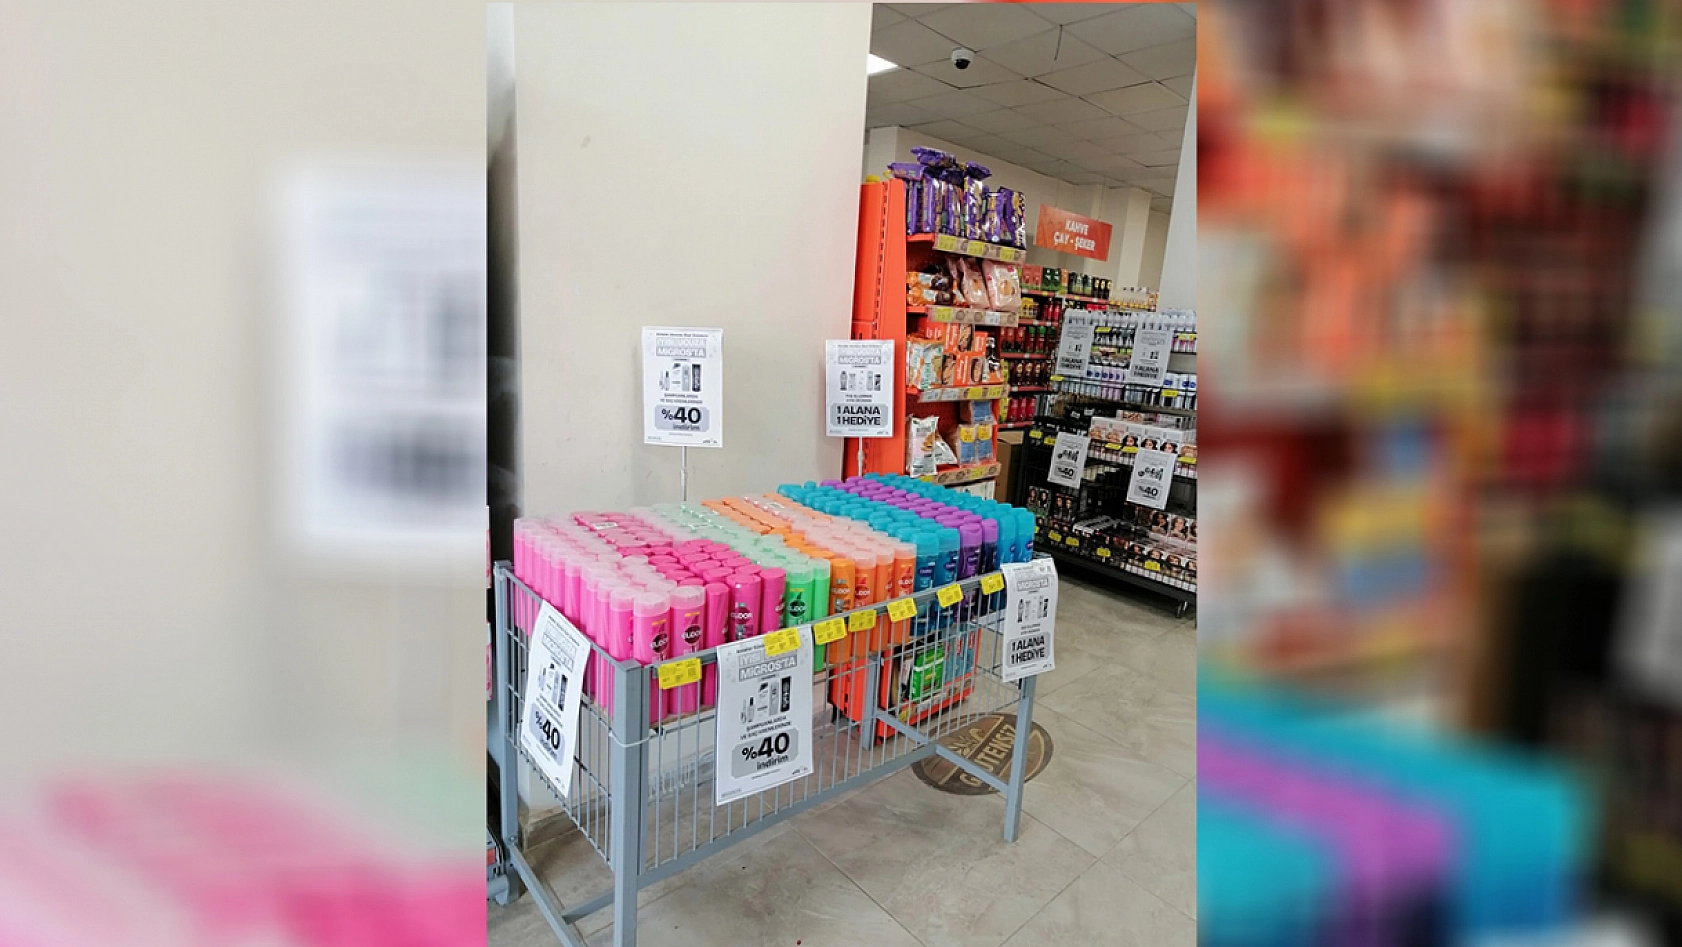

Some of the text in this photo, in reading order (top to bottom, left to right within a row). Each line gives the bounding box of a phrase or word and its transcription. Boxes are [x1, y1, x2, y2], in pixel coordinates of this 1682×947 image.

[1065, 219, 1089, 235] KAHVE
[1053, 231, 1095, 251] ÇAY ŞEKER
[661, 406, 702, 424] %40
[842, 405, 881, 415] ALANA
[1016, 635, 1045, 651] ALANA
[535, 710, 560, 750] %40
[741, 732, 790, 761] %40
[756, 754, 789, 770] indirim
[959, 723, 1016, 793] GUTENSİZ
